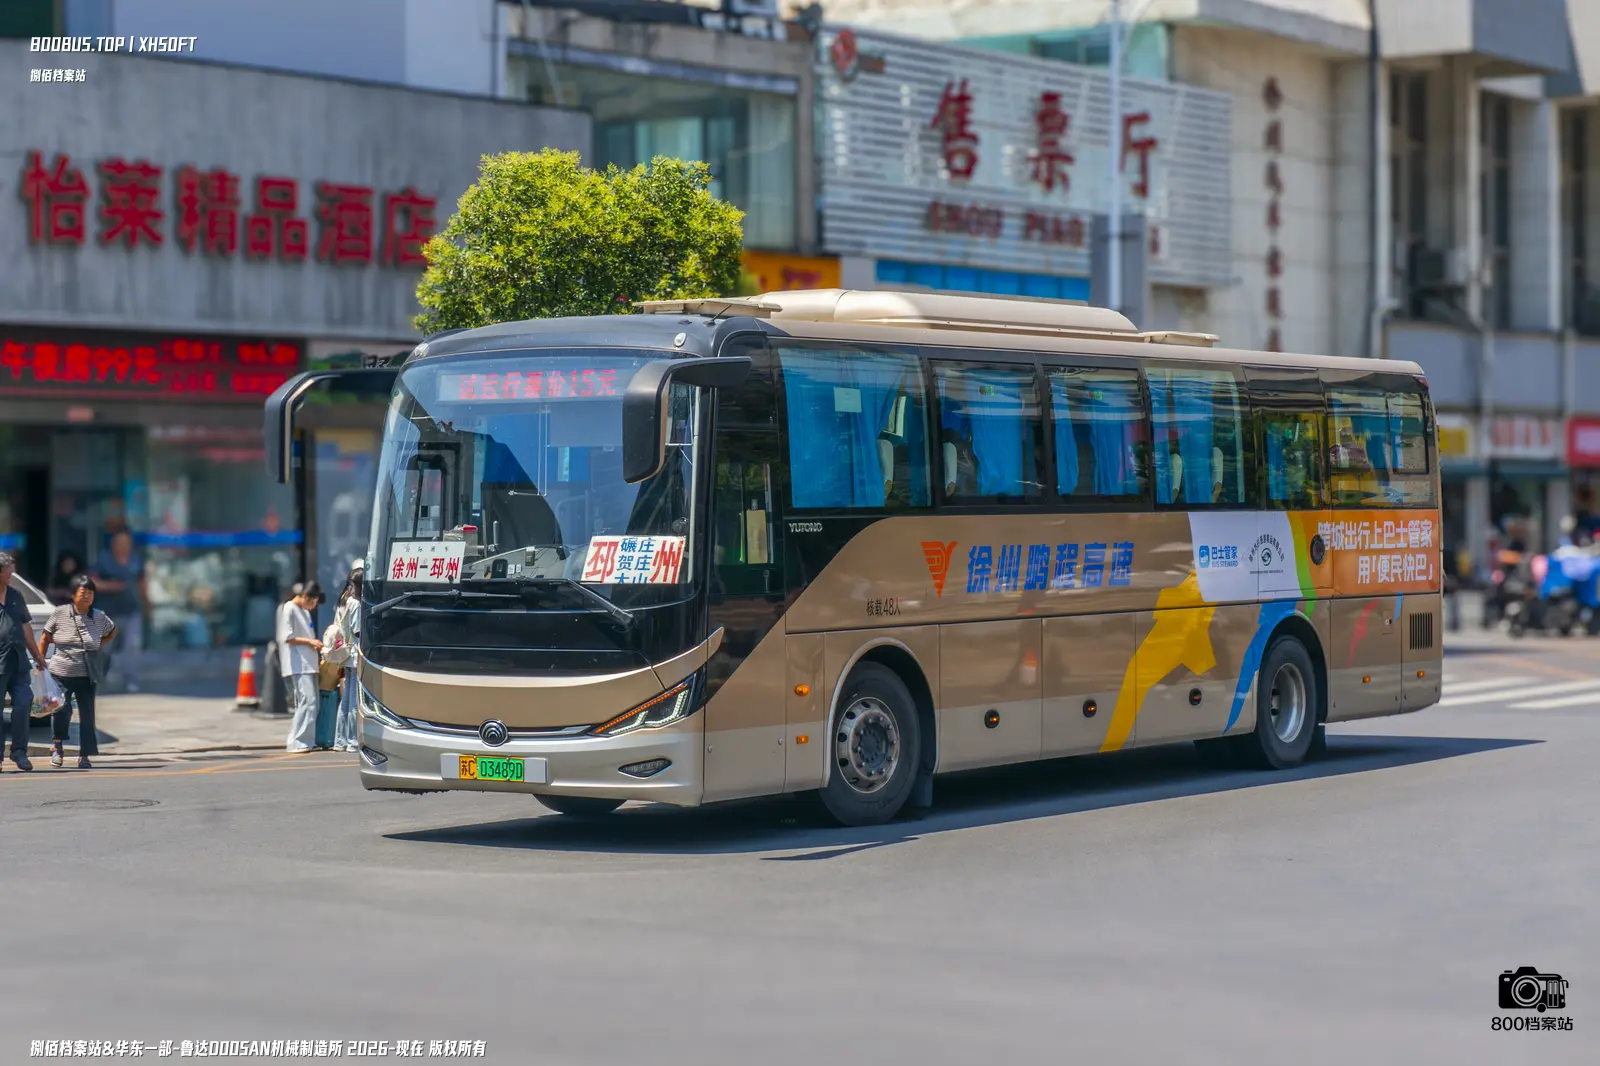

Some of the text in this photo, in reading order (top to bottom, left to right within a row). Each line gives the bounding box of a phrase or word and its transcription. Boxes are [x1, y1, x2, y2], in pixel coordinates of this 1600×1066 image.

[930, 77, 1157, 198] 售票厅
[21, 150, 437, 267] 怡莱精品酒店
[1211, 546, 1238, 560] 巴士管家
[1317, 519, 1433, 551] 跨城出行上巴士管家
[585, 540, 684, 584] 邳 州
[616, 555, 652, 571] 贺庄
[966, 541, 1134, 593] 徐州鹏程高速
[866, 597, 901, 616] 核载48人
